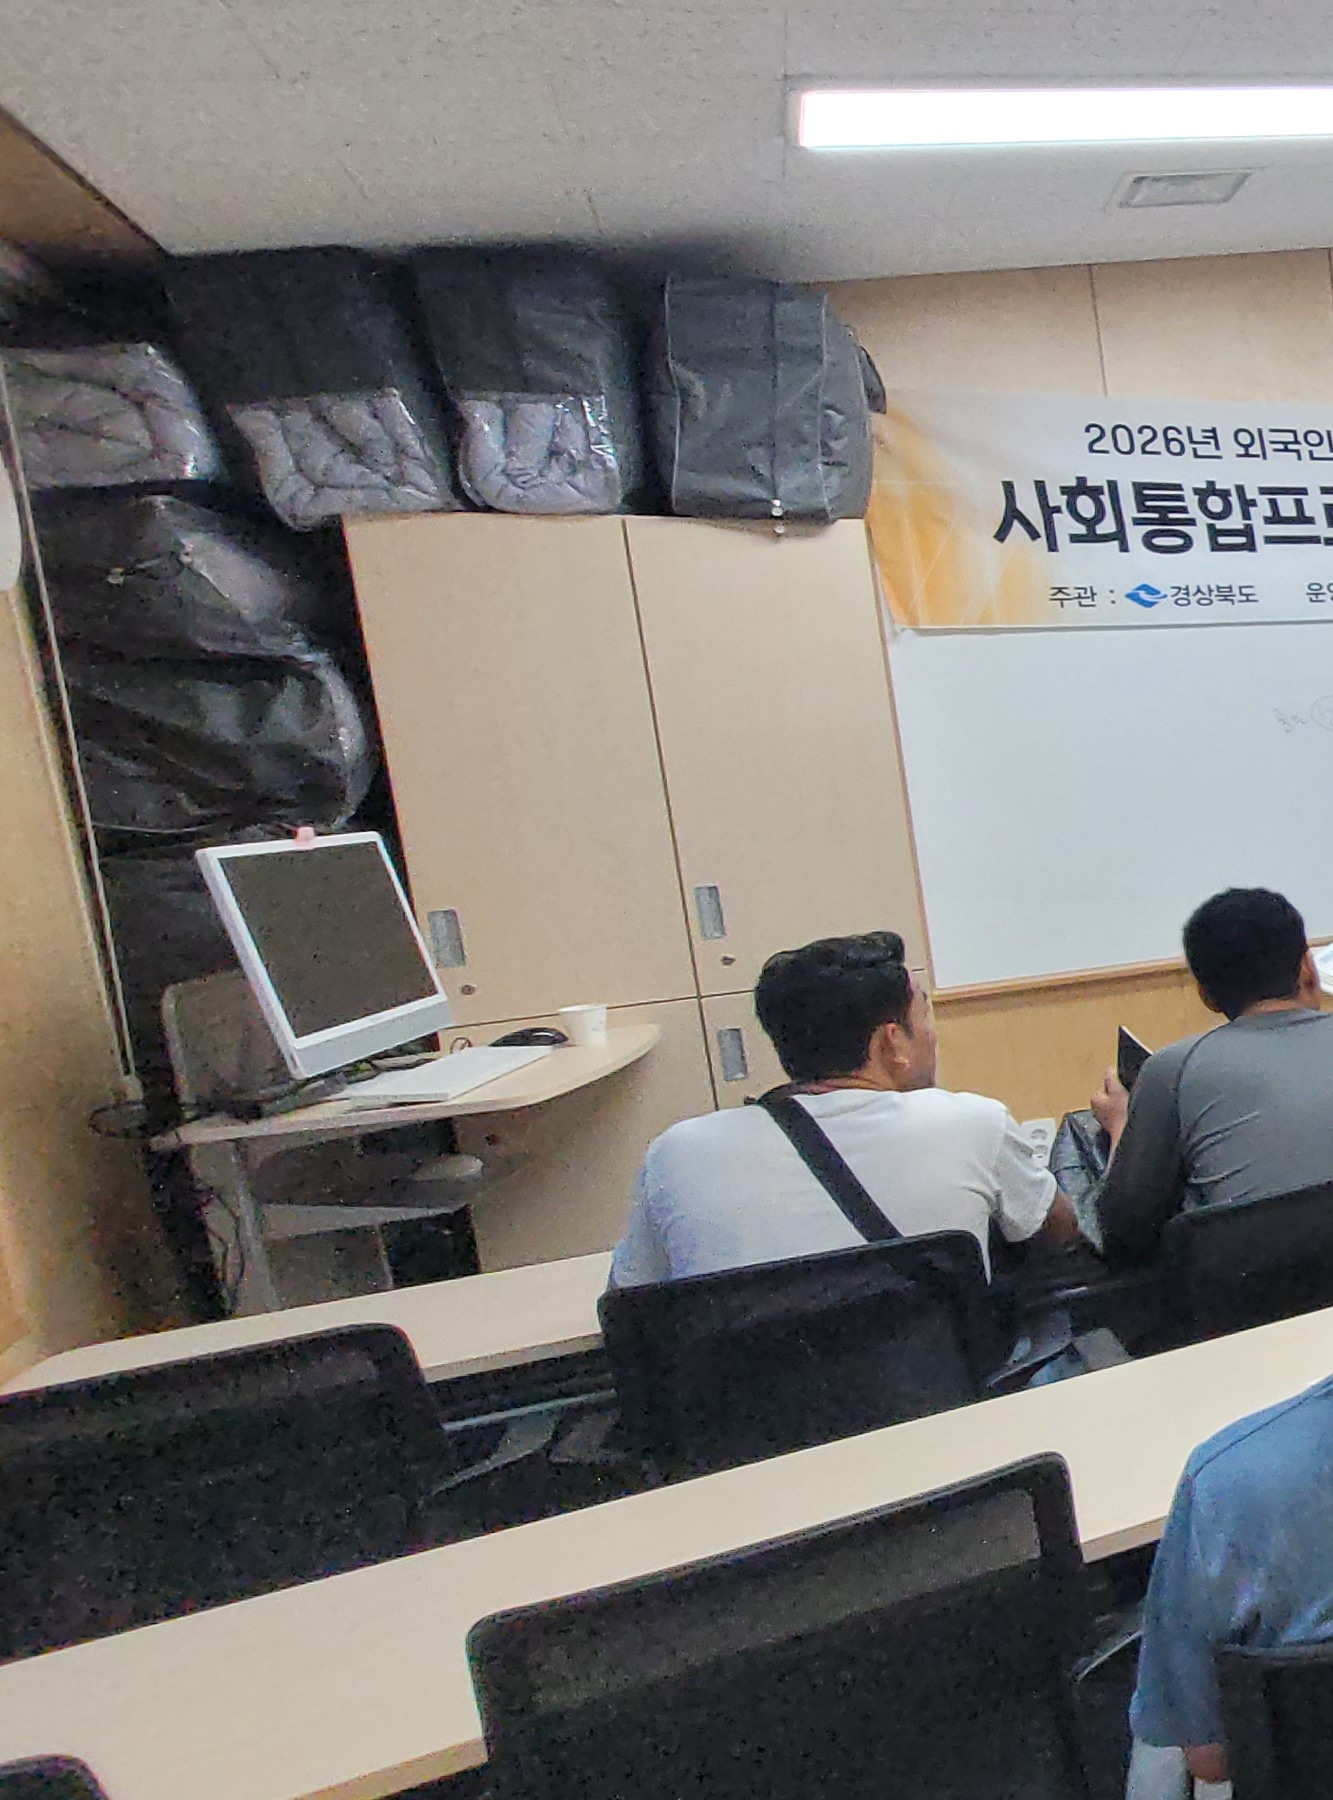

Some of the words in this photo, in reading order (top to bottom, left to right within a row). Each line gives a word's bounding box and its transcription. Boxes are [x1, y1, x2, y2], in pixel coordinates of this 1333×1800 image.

[1084, 423, 1223, 460] 2026년
[1049, 586, 1097, 609] 주관
[1170, 585, 1258, 607] 경상북도
